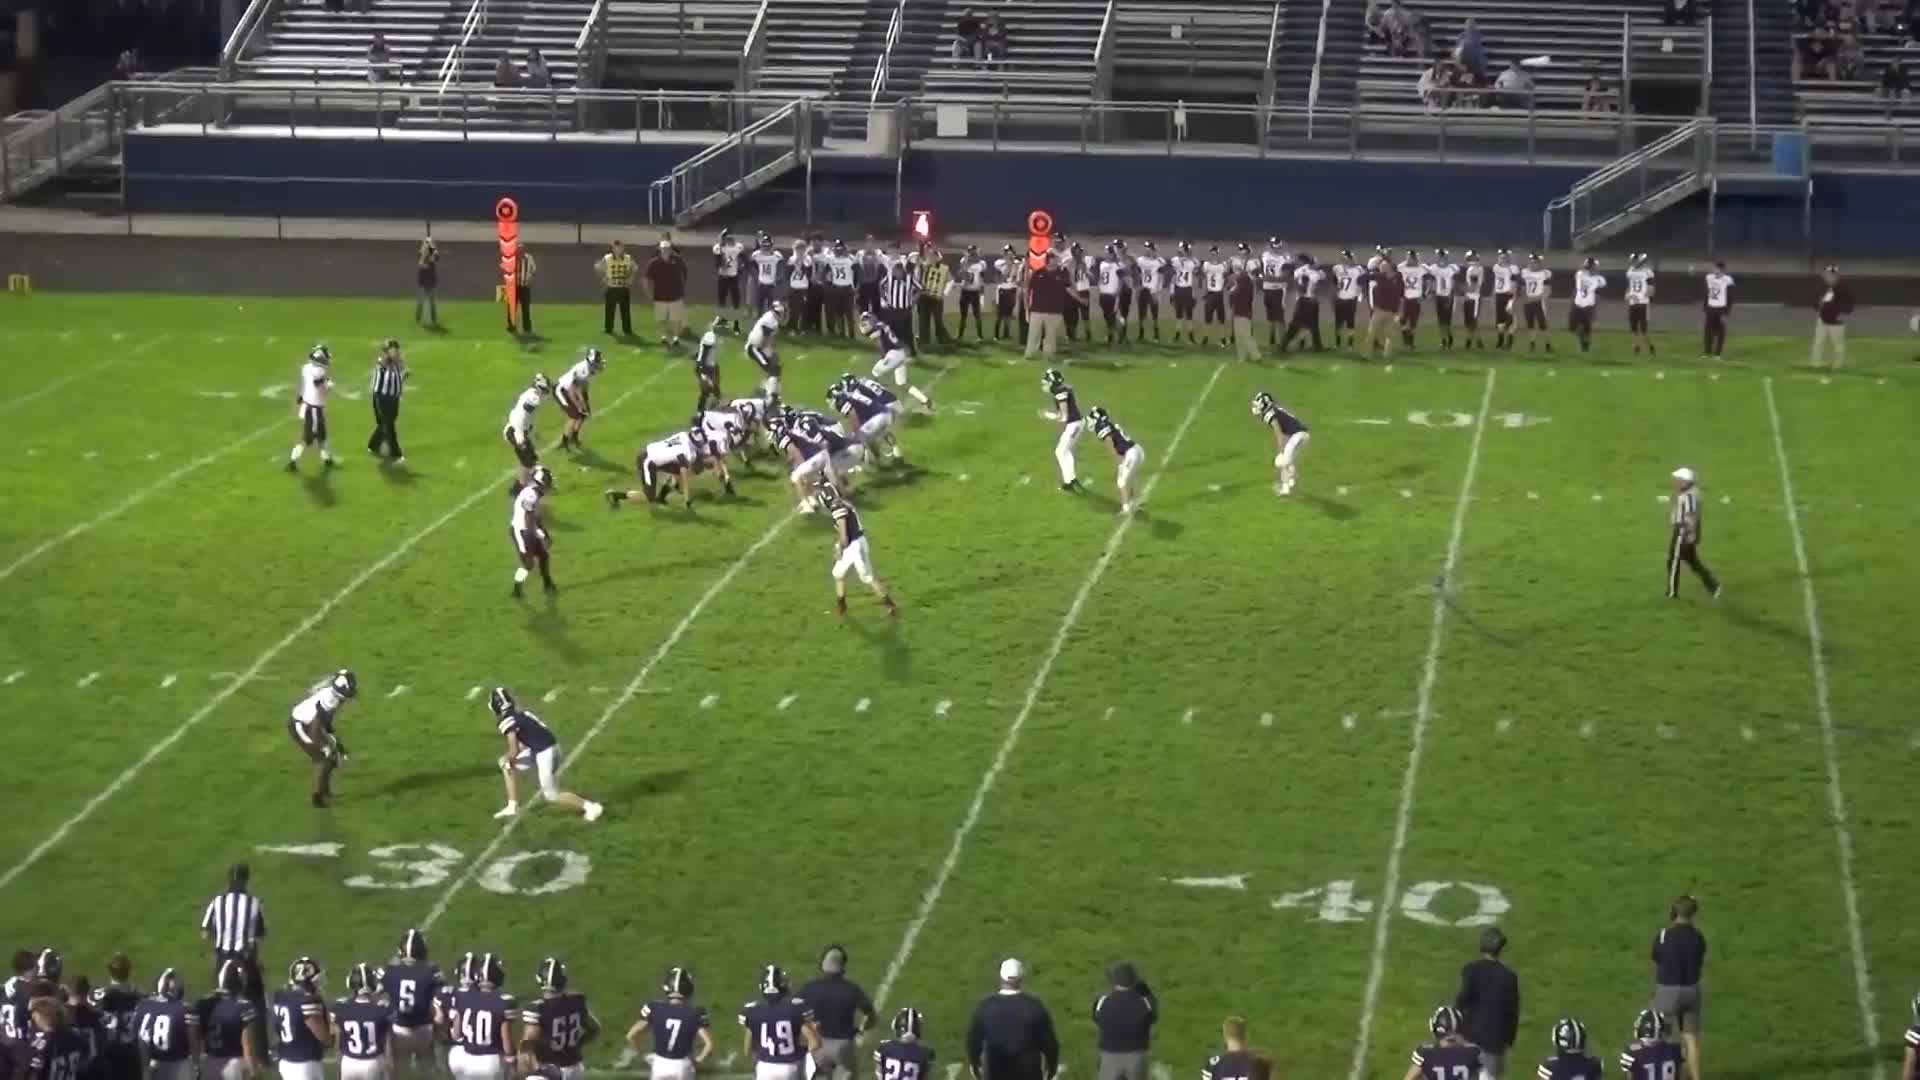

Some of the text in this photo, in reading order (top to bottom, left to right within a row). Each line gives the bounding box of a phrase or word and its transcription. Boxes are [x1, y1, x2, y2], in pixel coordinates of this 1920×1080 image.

[343, 842, 593, 896] 30
[1269, 878, 1512, 927] 40
[398, 979, 417, 1013] 5
[138, 1012, 172, 1051] 48
[342, 1019, 378, 1055] 31
[461, 1008, 493, 1046] 40
[664, 1018, 683, 1052] 7
[759, 1019, 796, 1056] 49
